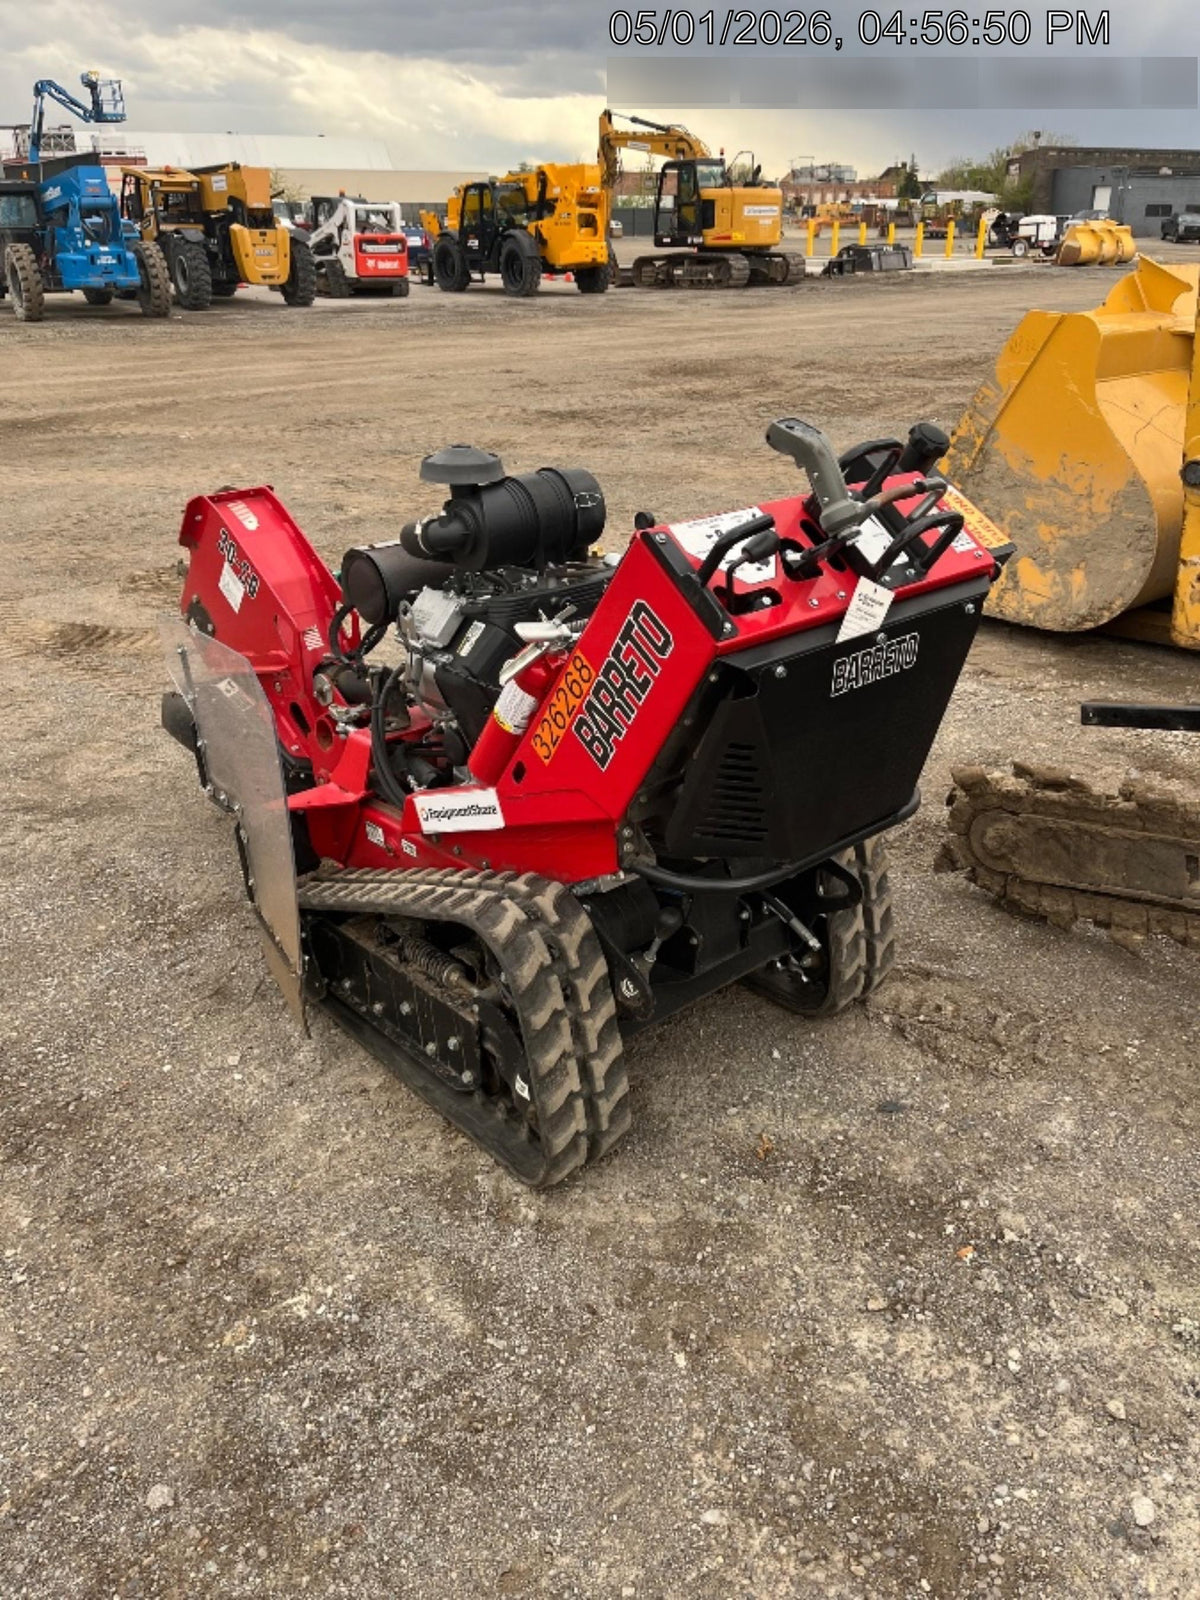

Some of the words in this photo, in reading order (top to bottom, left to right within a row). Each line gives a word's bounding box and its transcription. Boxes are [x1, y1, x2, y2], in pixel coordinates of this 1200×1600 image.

[532, 654, 593, 760] 326268
[571, 598, 675, 772] BARRETO
[830, 632, 920, 698] BARRETO
[428, 803, 498, 822] EquipmentShare
